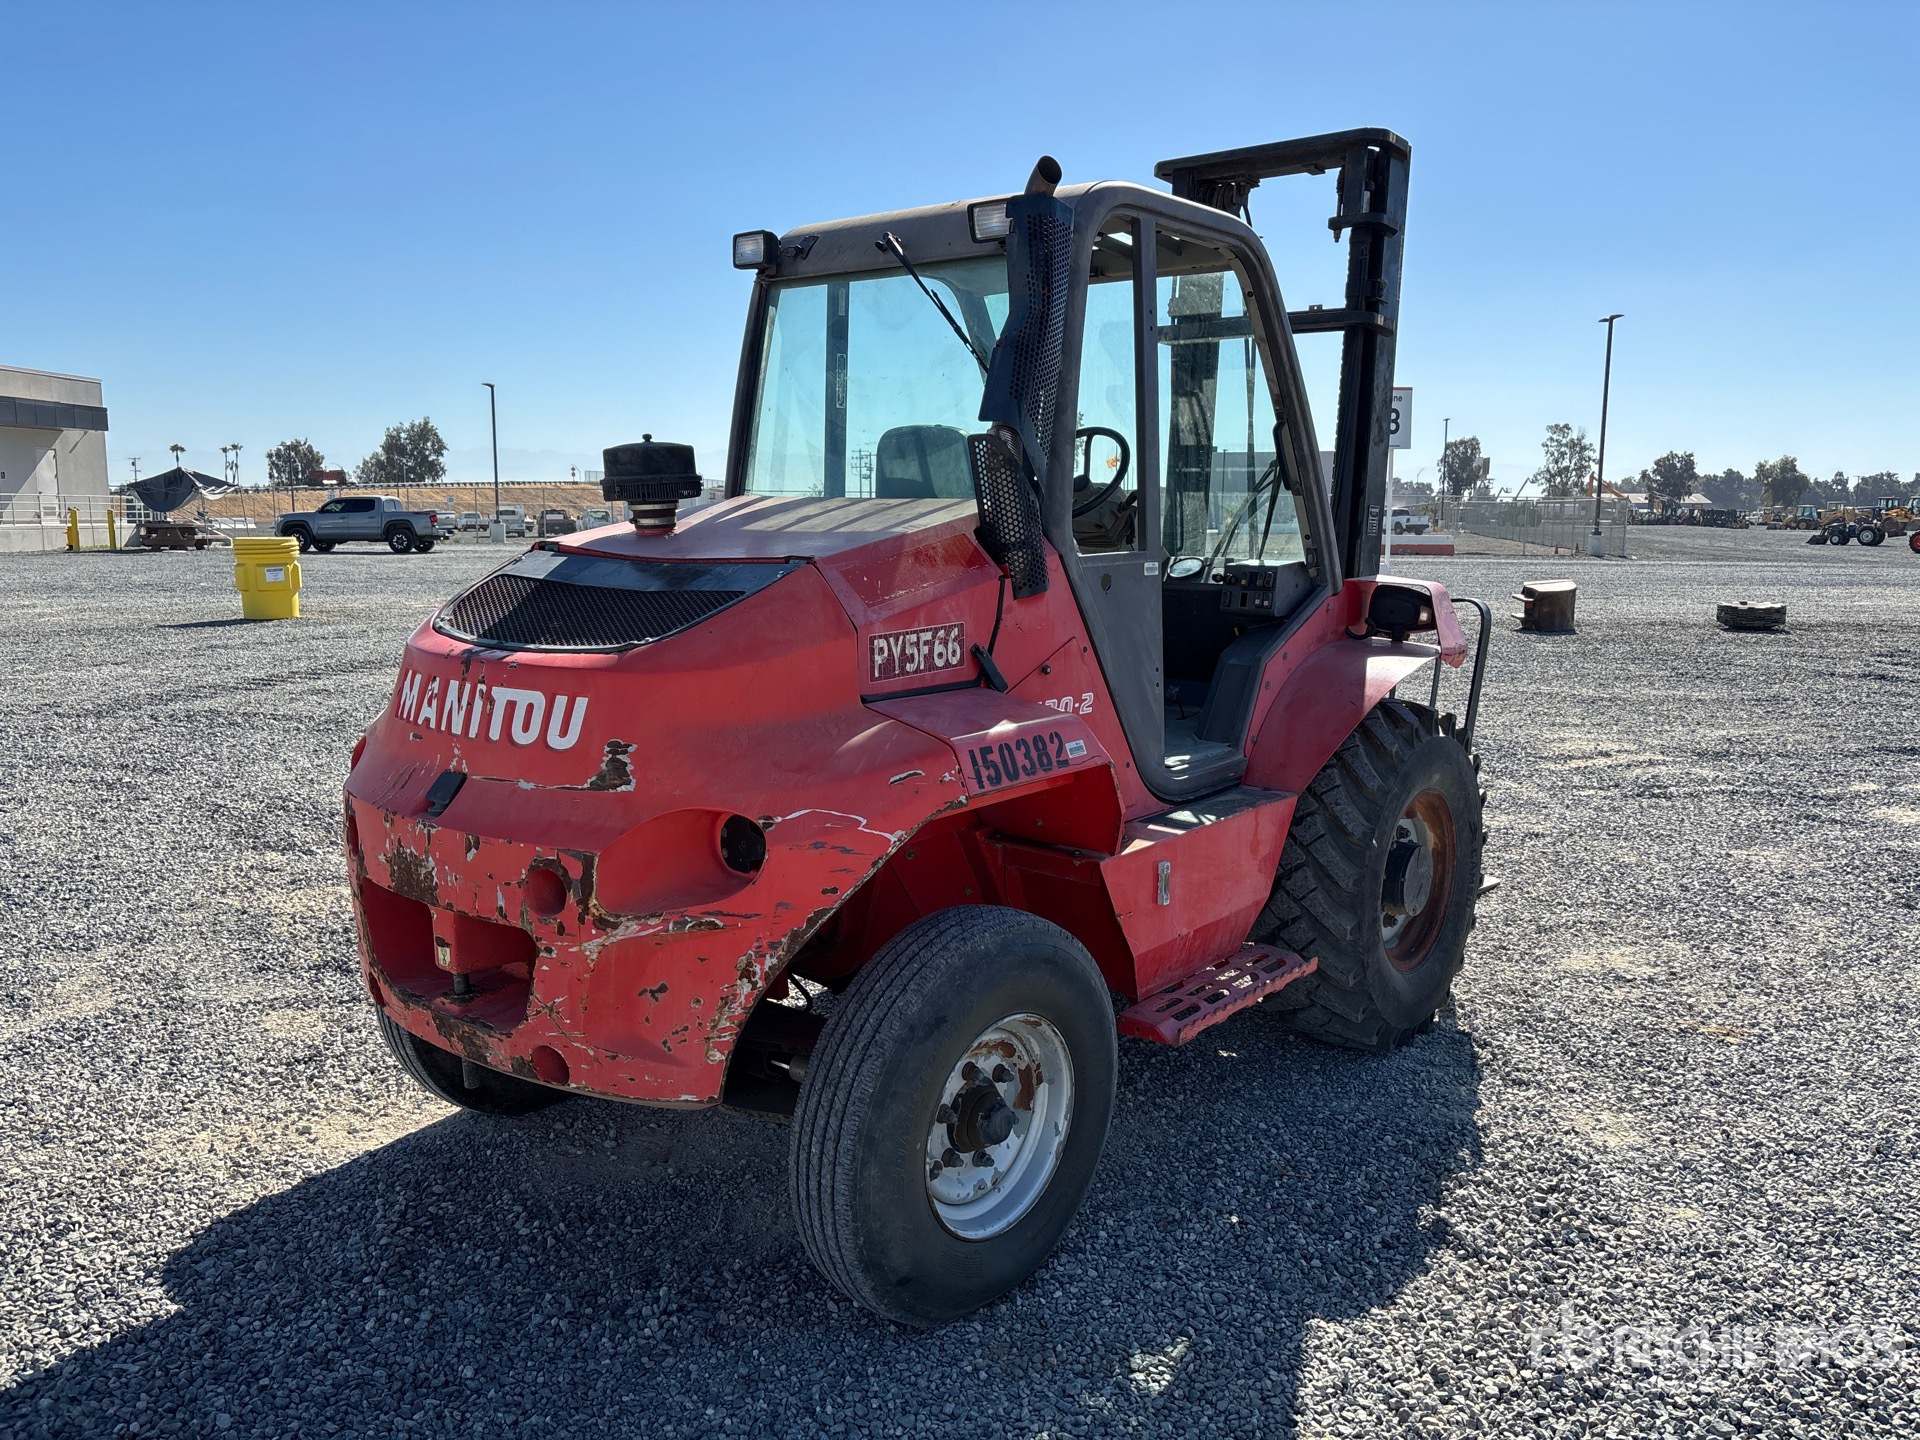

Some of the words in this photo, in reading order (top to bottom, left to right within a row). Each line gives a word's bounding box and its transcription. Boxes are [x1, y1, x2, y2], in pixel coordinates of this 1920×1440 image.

[874, 626, 962, 677] PY5F66
[399, 669, 589, 751] MANITOU
[968, 731, 1070, 790] 150382
